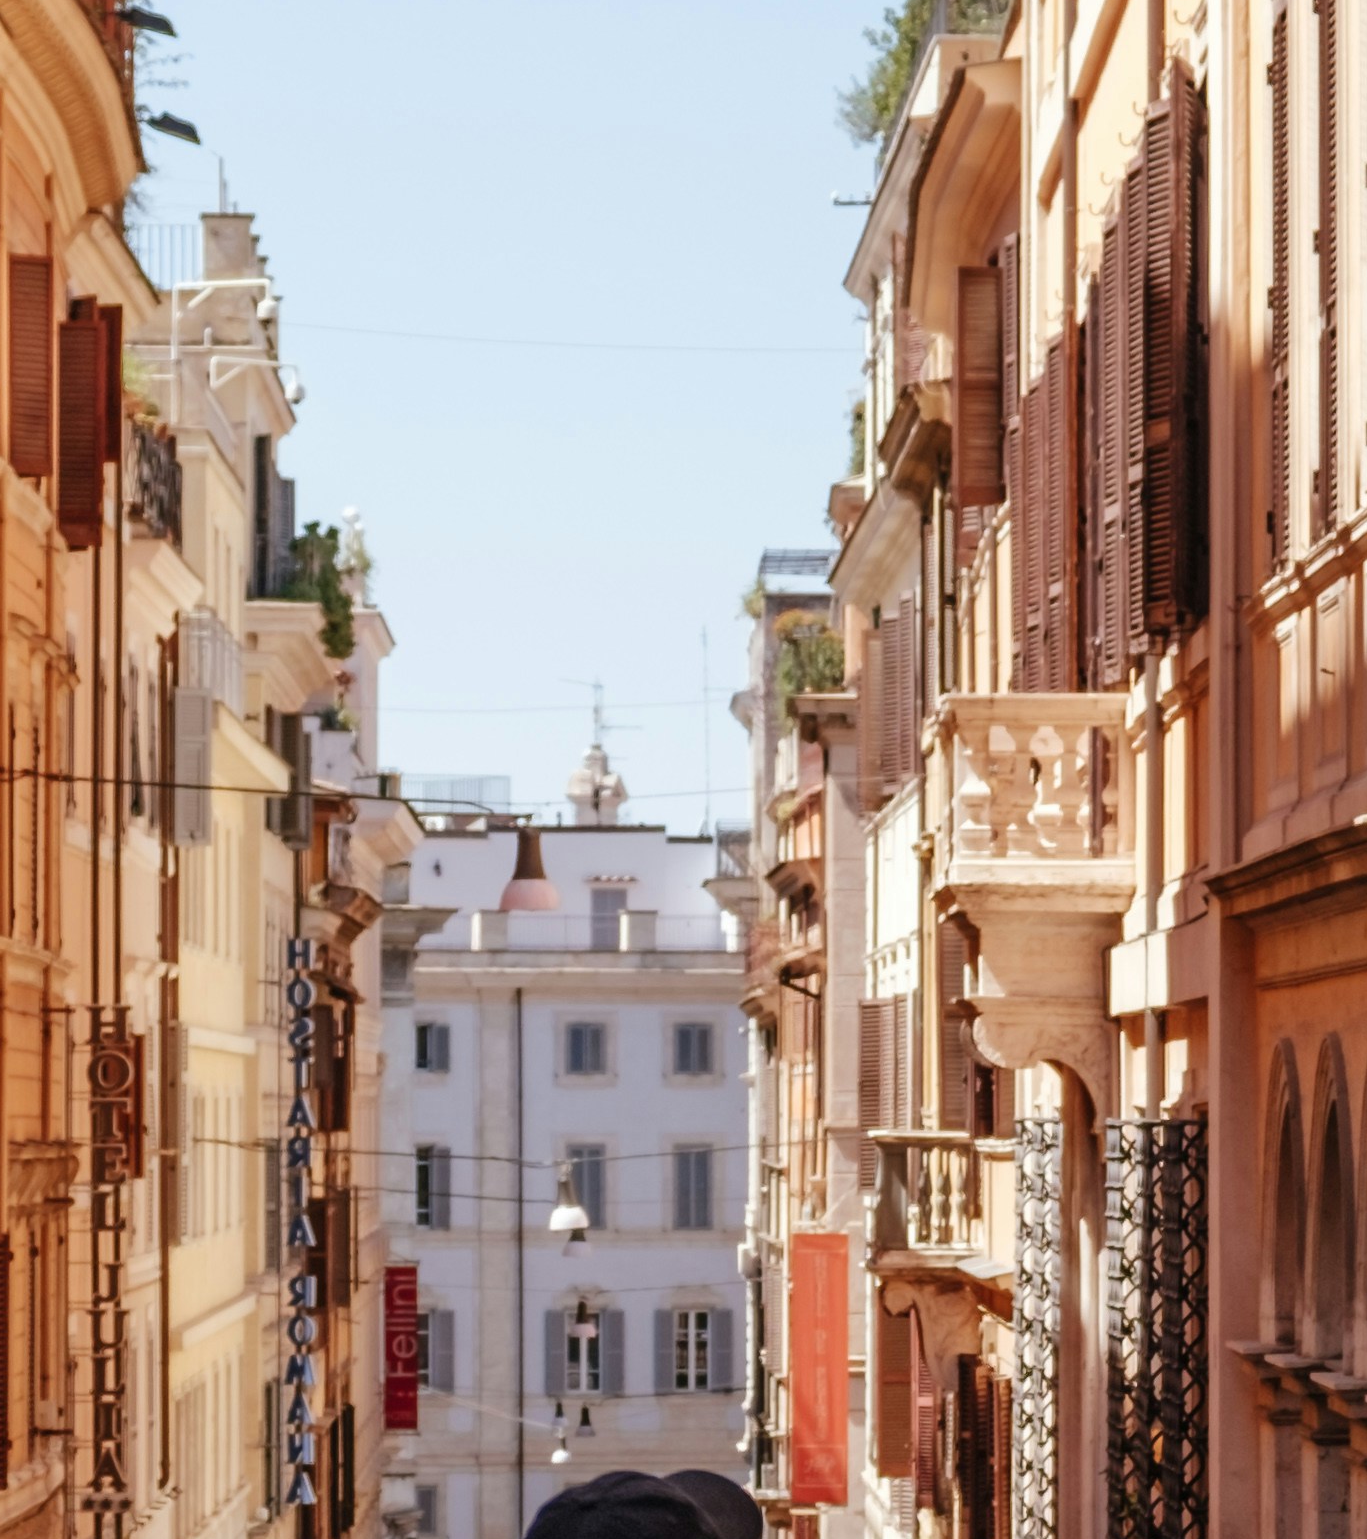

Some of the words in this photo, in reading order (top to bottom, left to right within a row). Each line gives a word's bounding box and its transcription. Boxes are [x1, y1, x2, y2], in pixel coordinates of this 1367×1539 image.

[87, 1005, 134, 1232] HOTEL
[86, 1263, 130, 1494] JULIA
[385, 1275, 418, 1378] Fellini
